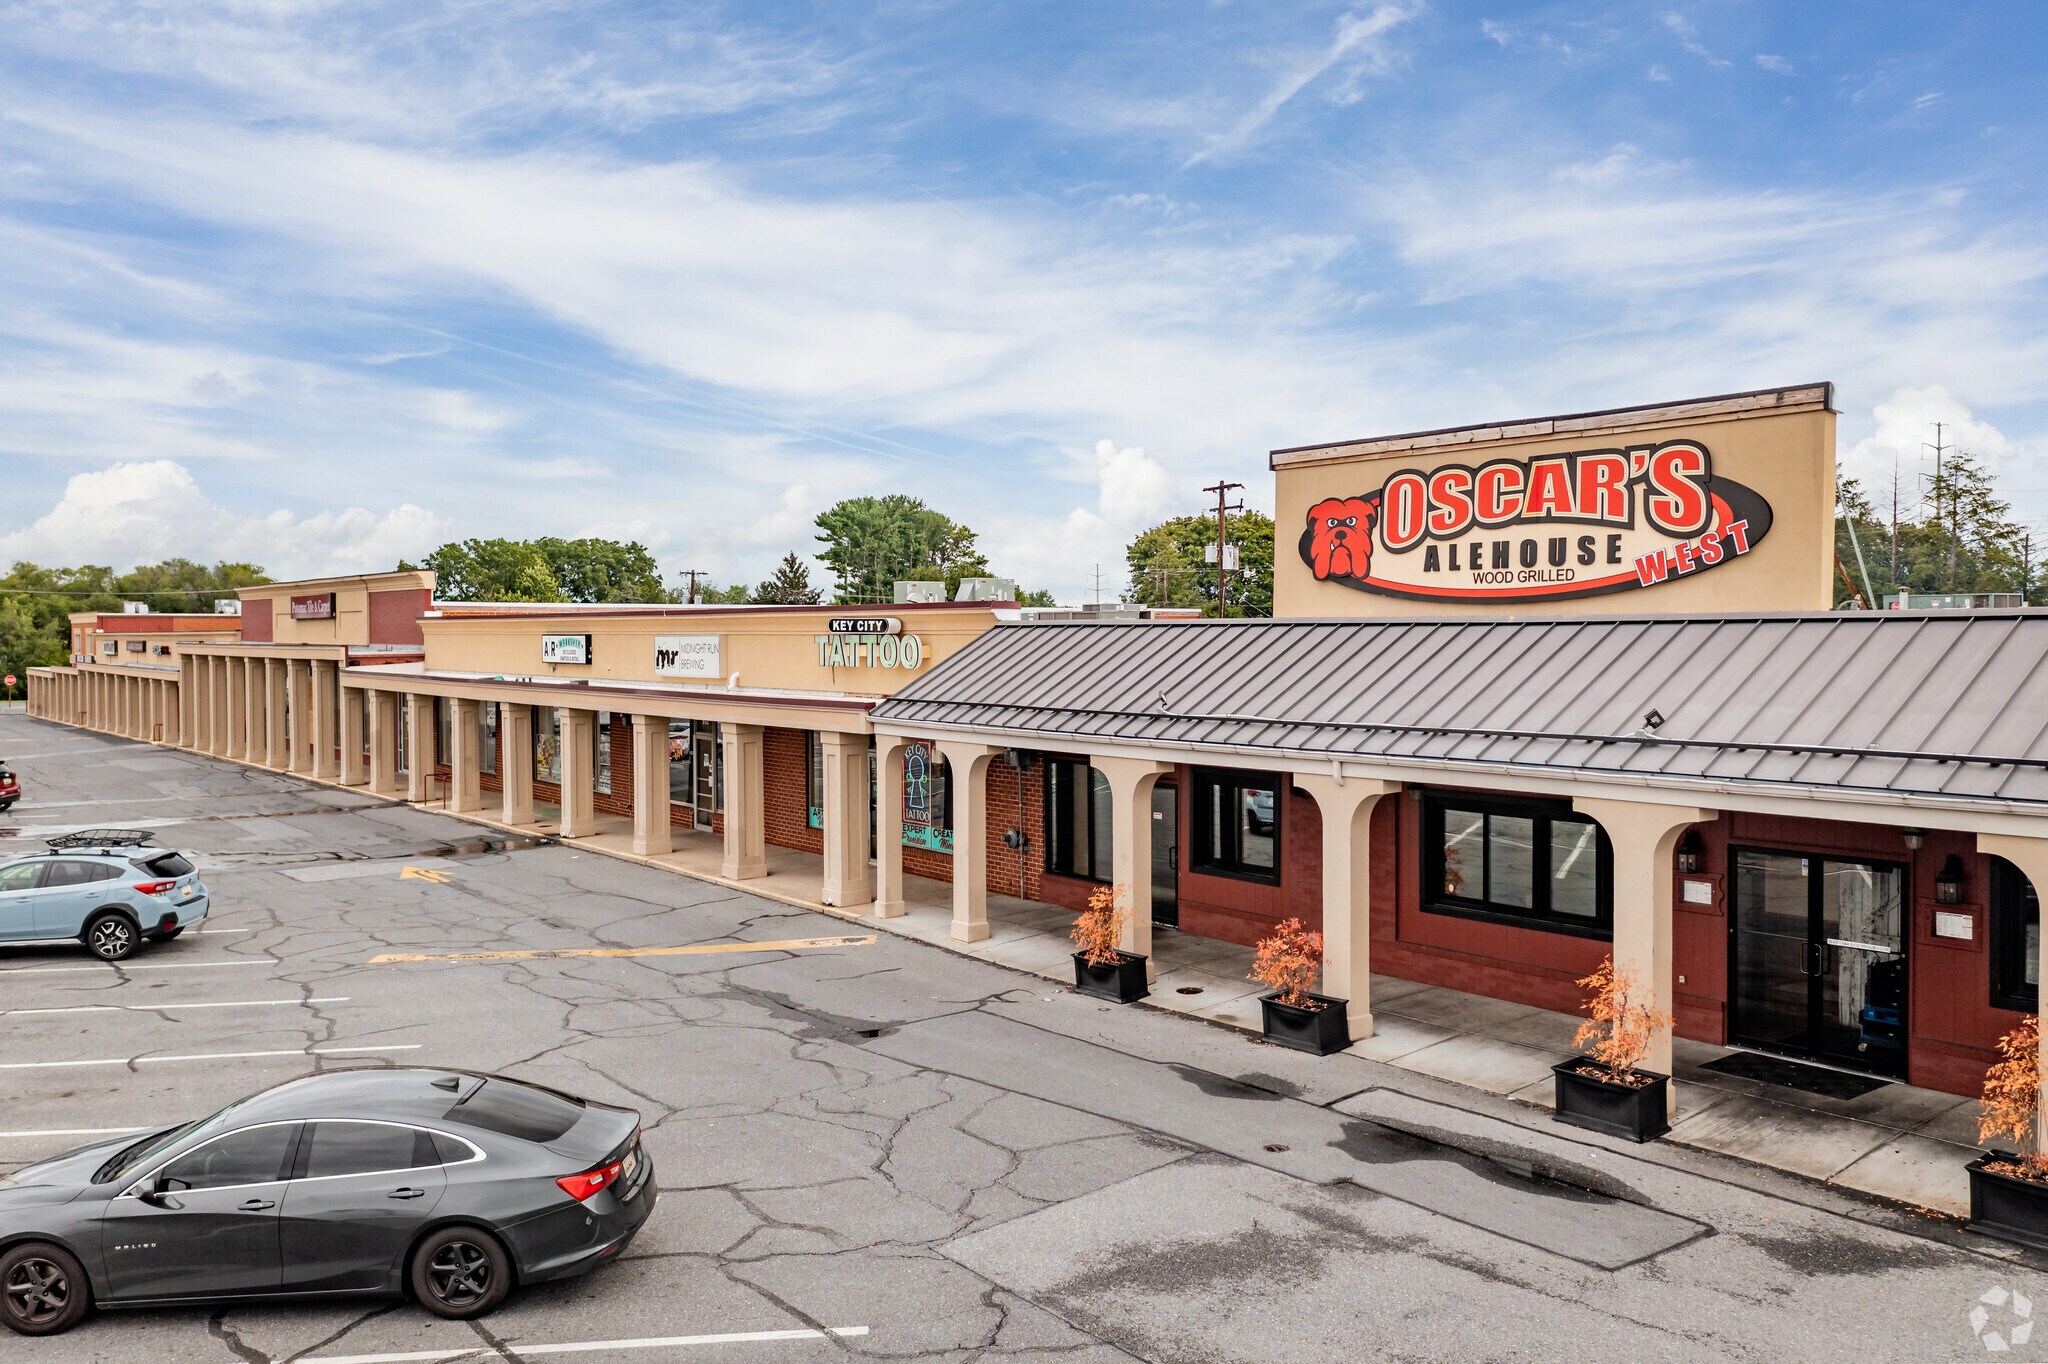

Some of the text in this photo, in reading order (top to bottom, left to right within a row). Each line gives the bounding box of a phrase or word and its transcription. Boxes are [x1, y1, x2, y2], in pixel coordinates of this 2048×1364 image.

[1381, 442, 1708, 551] OSCAR'S
[1423, 533, 1623, 572] ALEHOUSE
[1634, 518, 1753, 588] WEST
[1472, 567, 1576, 585] WOOD GRILLED
[832, 620, 883, 631] KEY CITY
[559, 638, 581, 649] WORKSHOP
[681, 643, 719, 654] MIDNIGHT RUN
[814, 634, 922, 670] TATTOO
[681, 659, 704, 670] BREWING
[904, 744, 928, 760] KEY CITY
[905, 808, 930, 822] TATTOO
[903, 824, 926, 835] EXPERT
